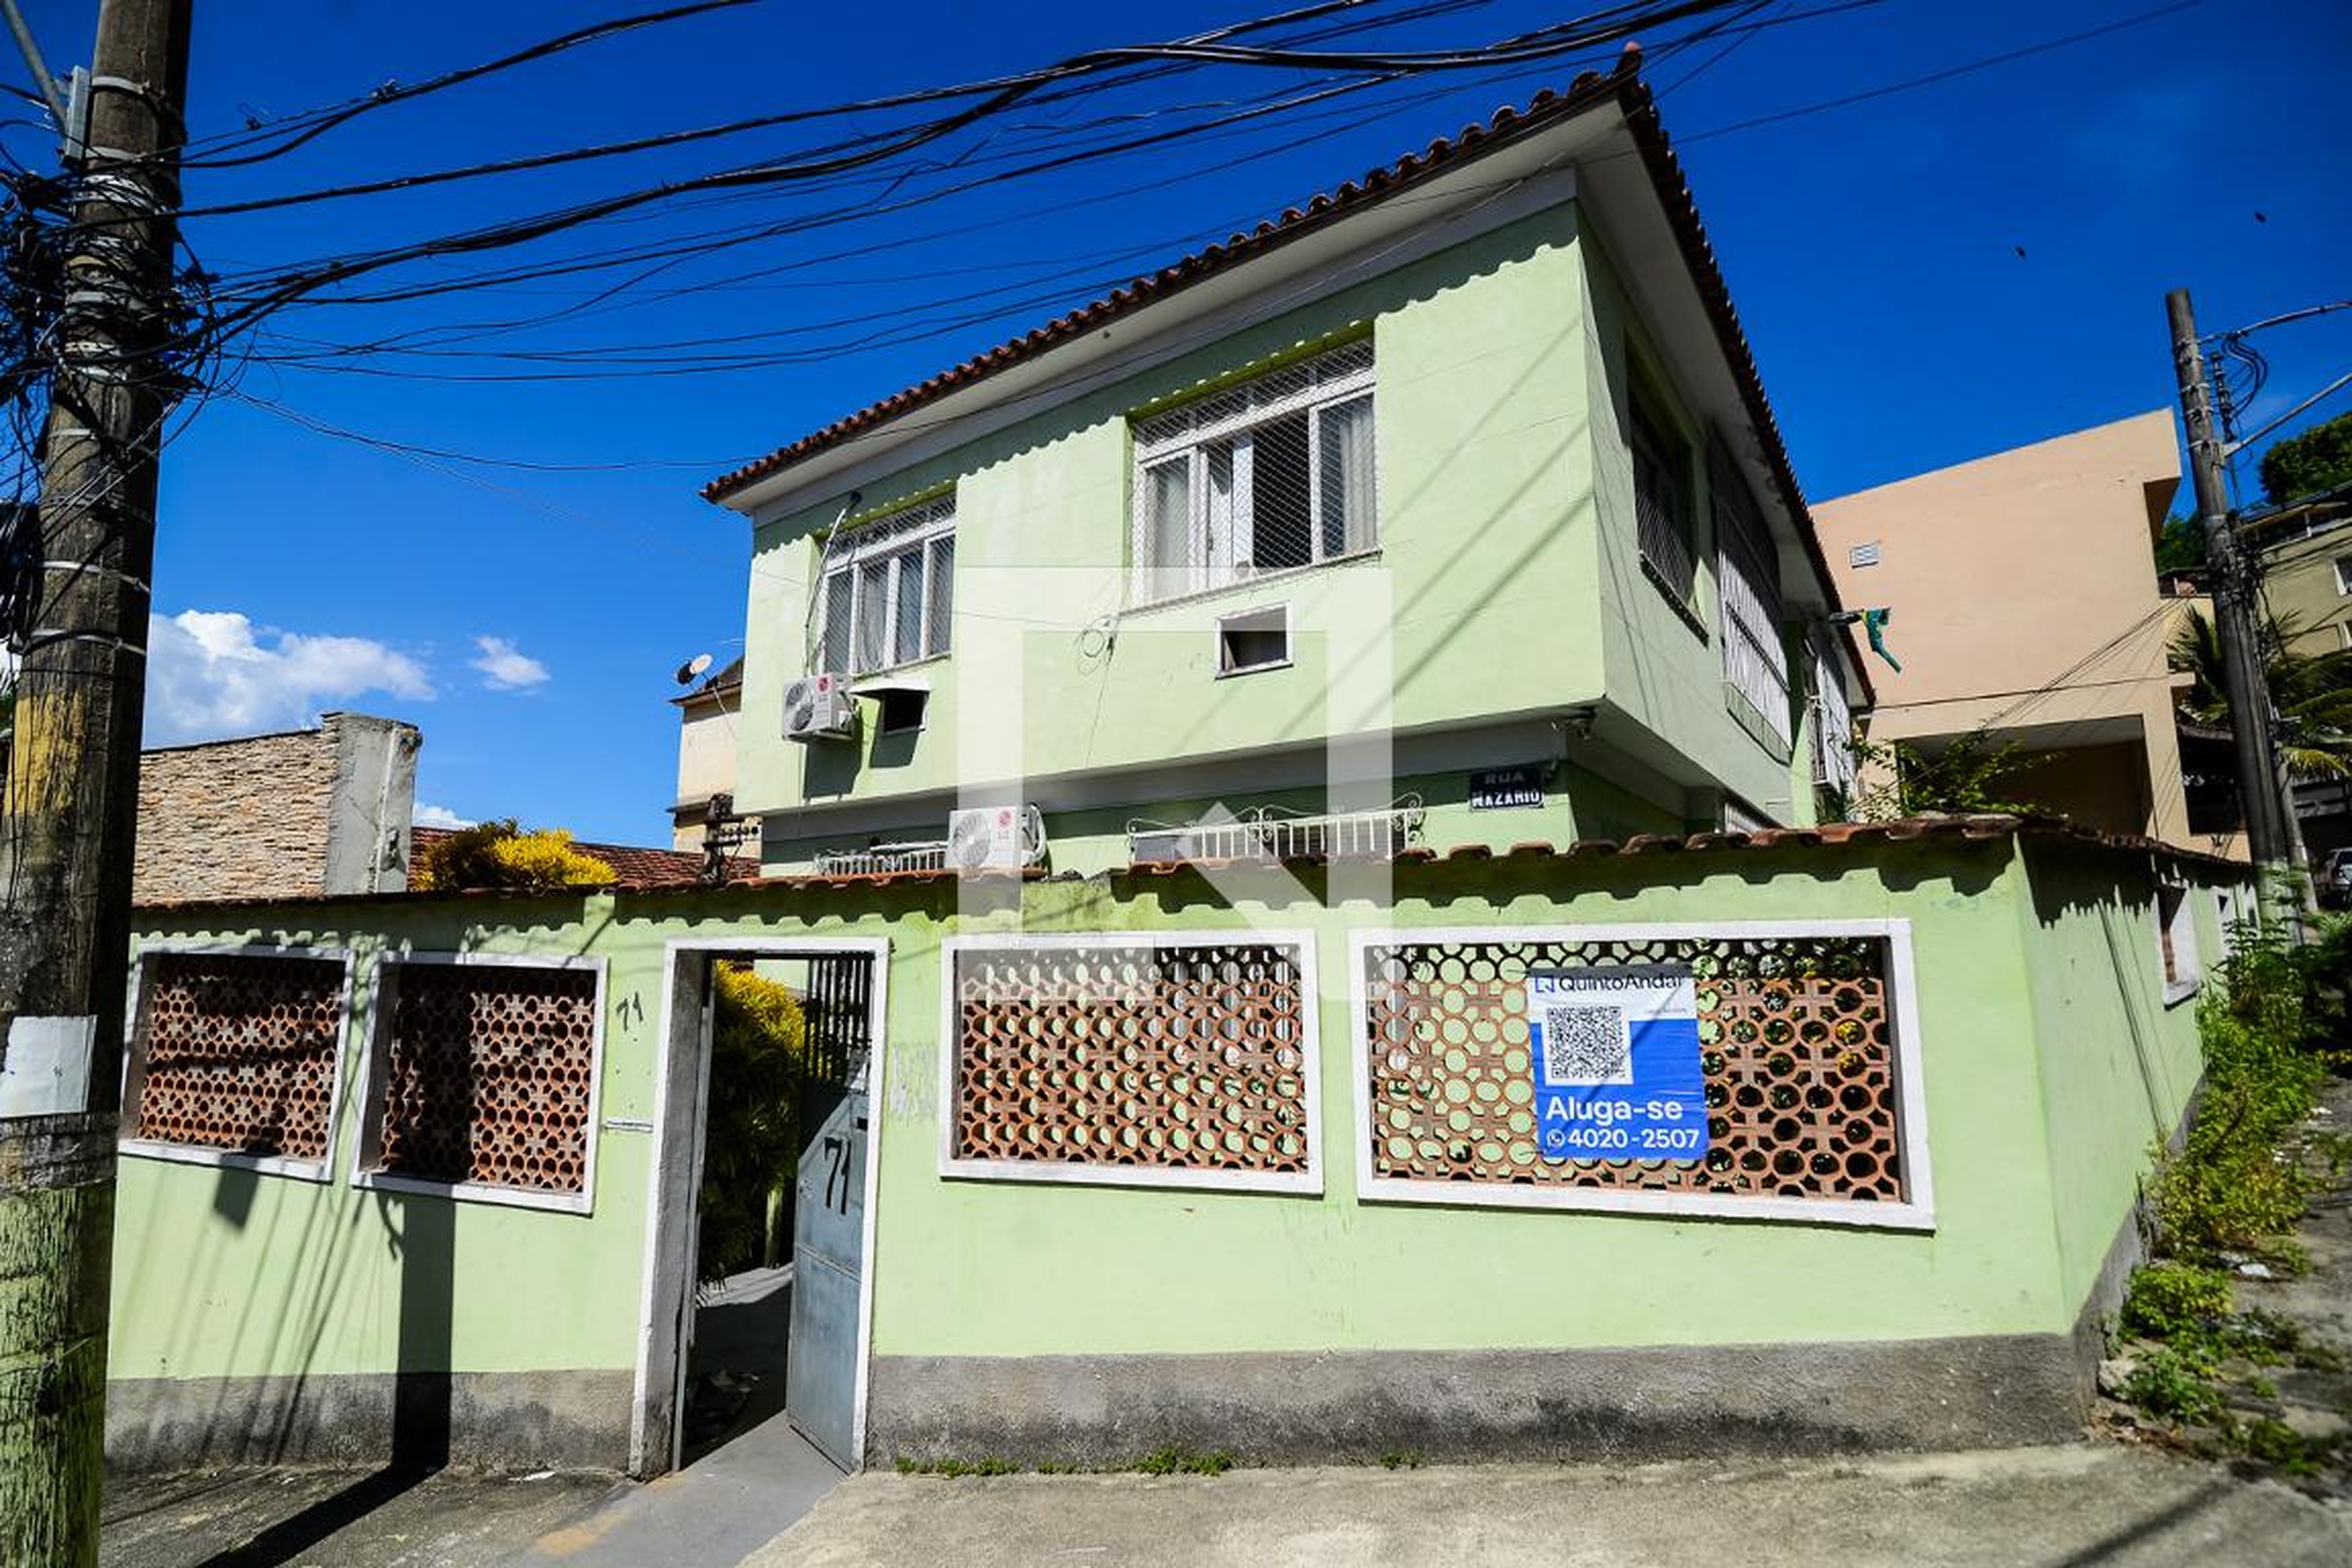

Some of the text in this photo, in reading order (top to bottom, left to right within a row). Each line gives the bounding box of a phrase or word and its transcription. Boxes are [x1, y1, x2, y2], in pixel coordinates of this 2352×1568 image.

[1485, 771, 1524, 784] RUA
[1545, 1096, 1683, 1126] Aluga-se
[824, 1136, 853, 1215] 71
